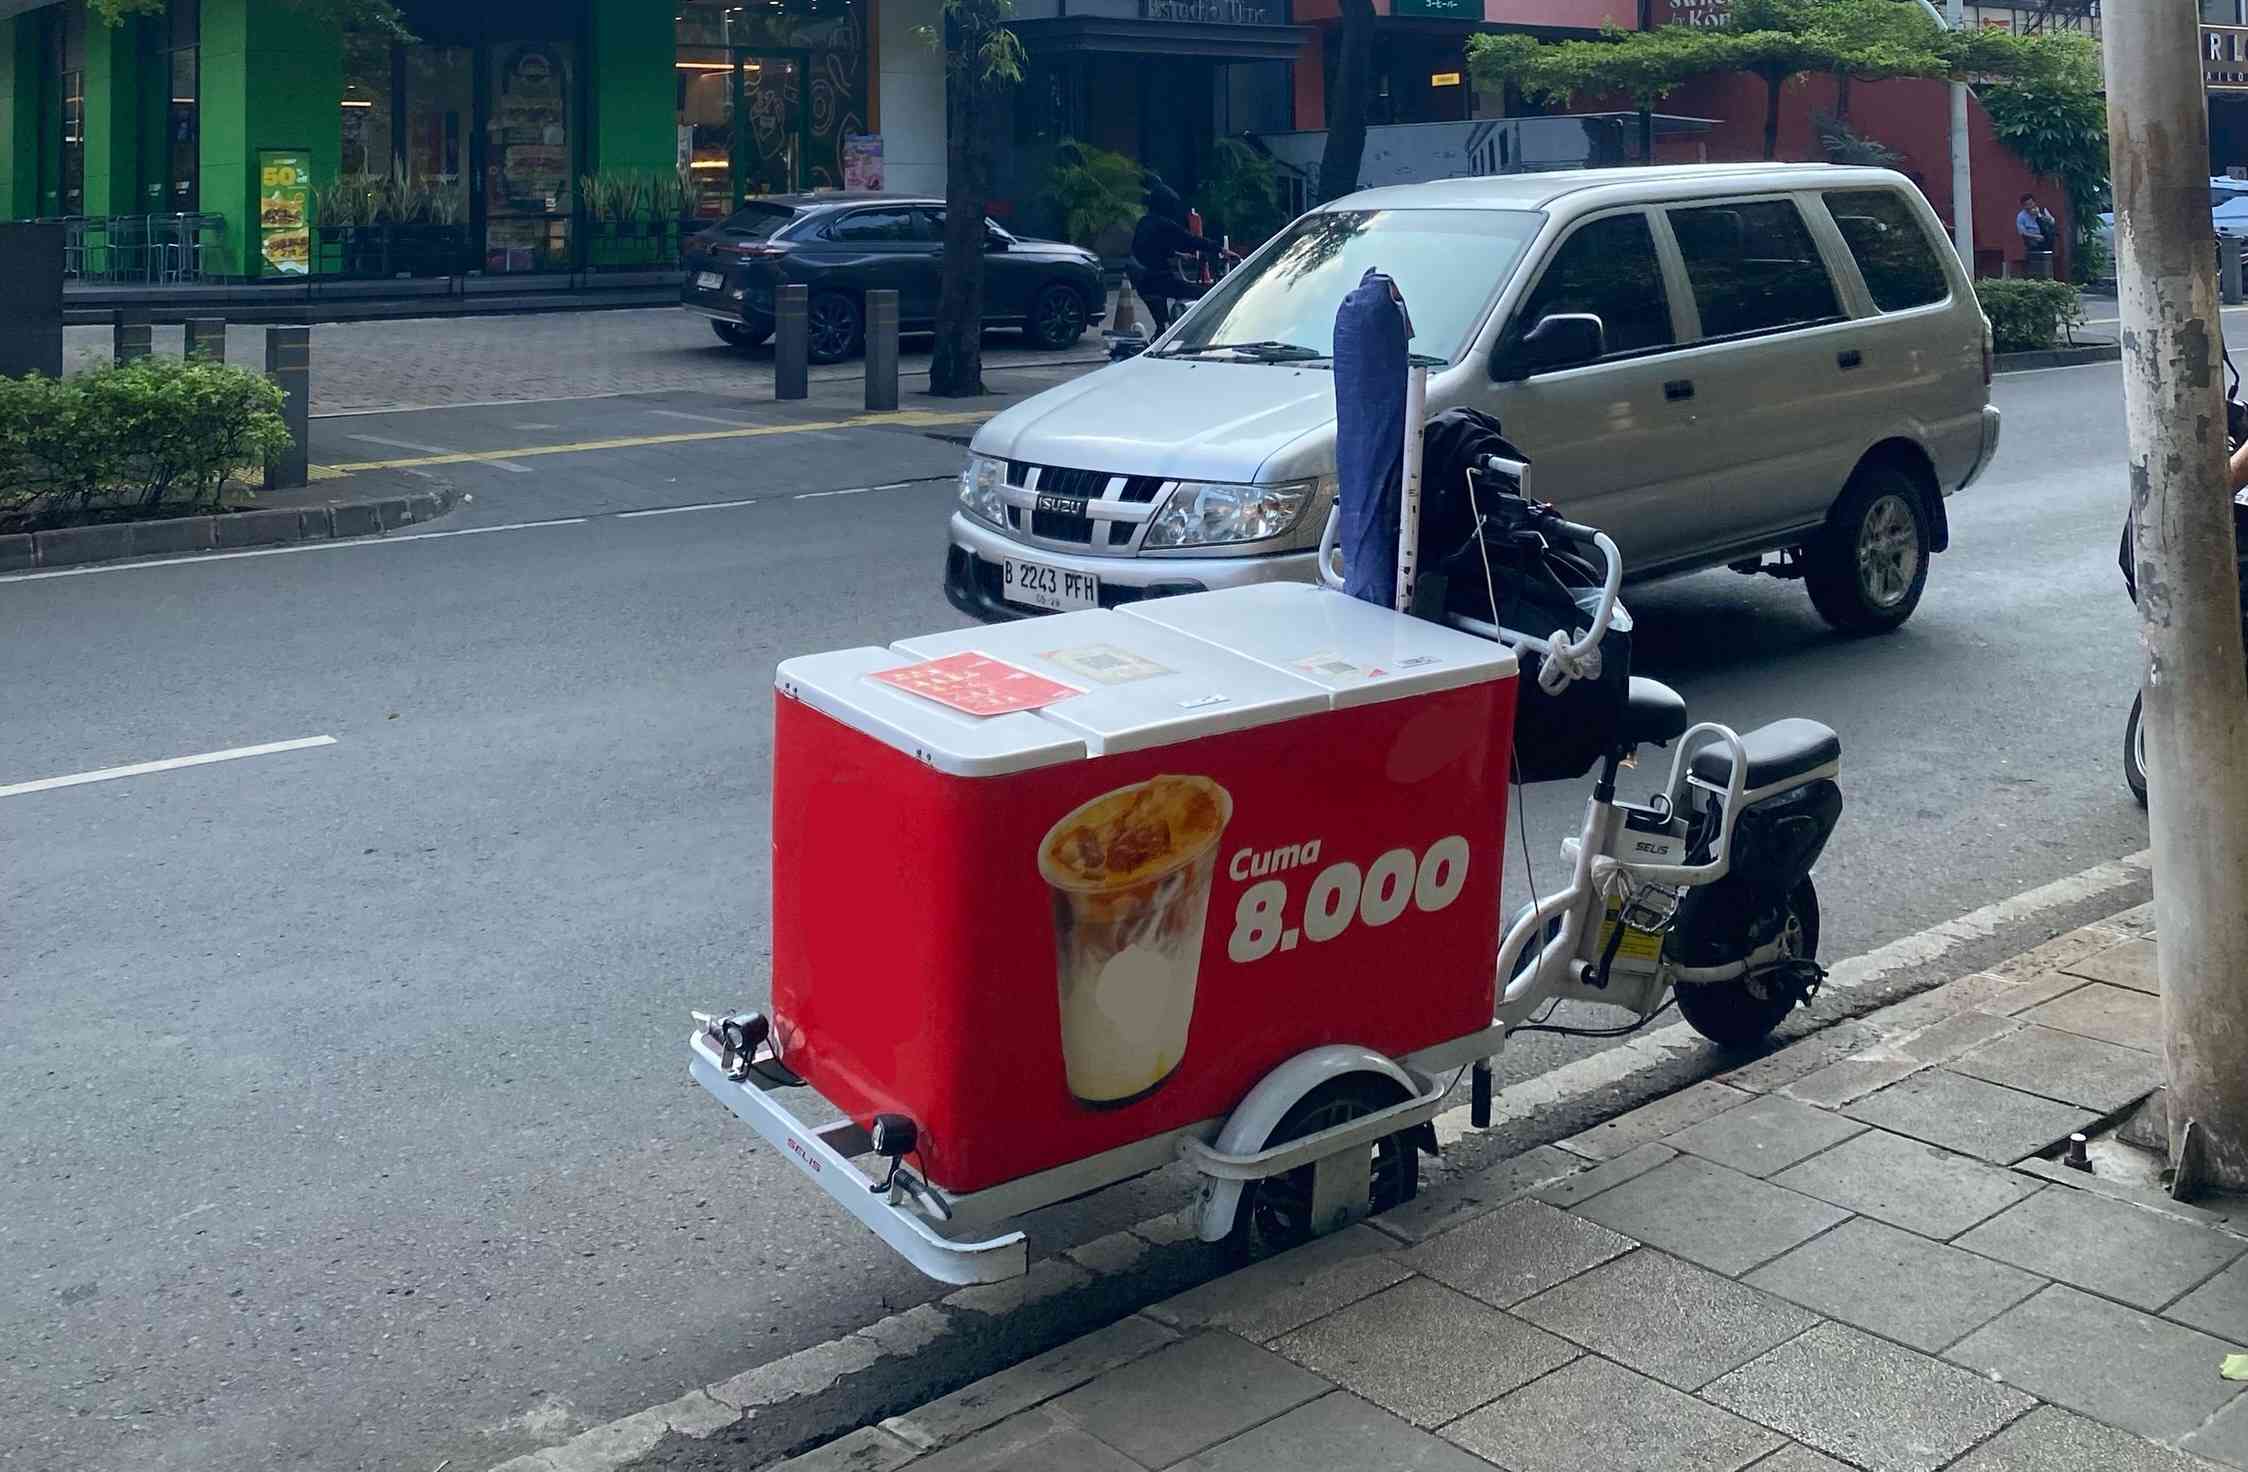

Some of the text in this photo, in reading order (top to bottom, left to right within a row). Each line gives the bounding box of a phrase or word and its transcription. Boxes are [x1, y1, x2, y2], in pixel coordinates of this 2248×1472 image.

[263, 166, 297, 186] 50
[1038, 496, 1081, 514] ISUZU
[1004, 560, 1013, 585] B
[1020, 564, 1057, 593] 2243
[1064, 572, 1095, 601] PFH
[1229, 839, 1322, 881] Cuma
[1635, 841, 1669, 855] SELIS
[1227, 834, 1470, 963] 8.000
[786, 1137, 822, 1172] SELIS
